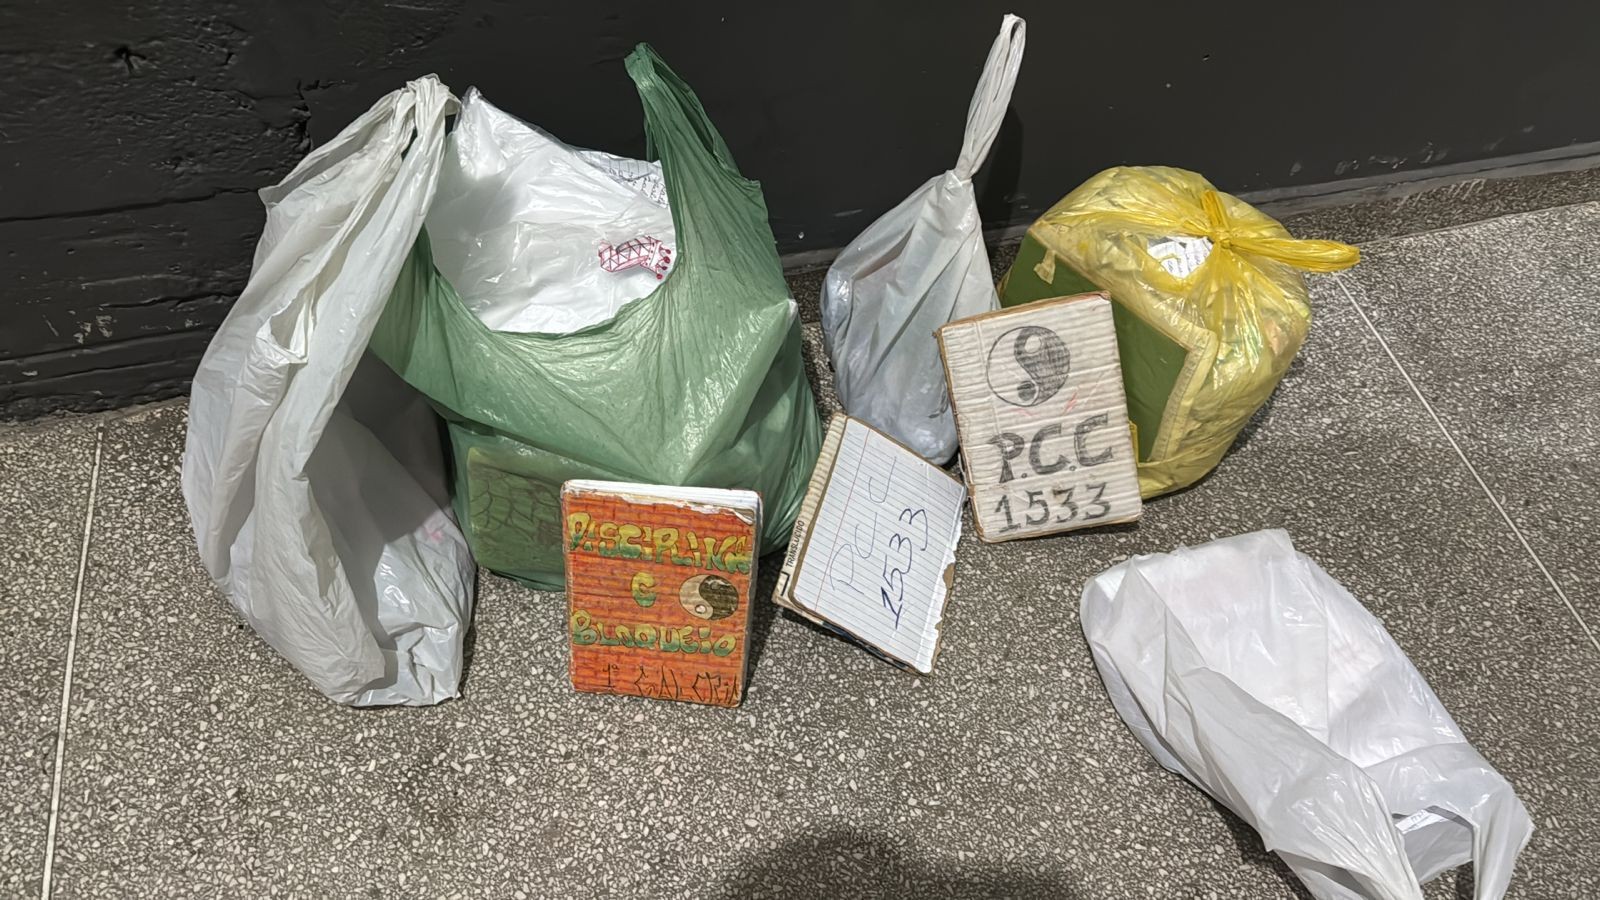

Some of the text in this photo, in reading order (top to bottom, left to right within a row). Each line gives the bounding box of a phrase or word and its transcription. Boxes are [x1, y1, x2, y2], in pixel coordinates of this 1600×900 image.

[987, 411, 1115, 484] P.C.C
[829, 456, 897, 595] PCC
[994, 482, 1112, 533] 1533
[880, 508, 929, 630] 1533
